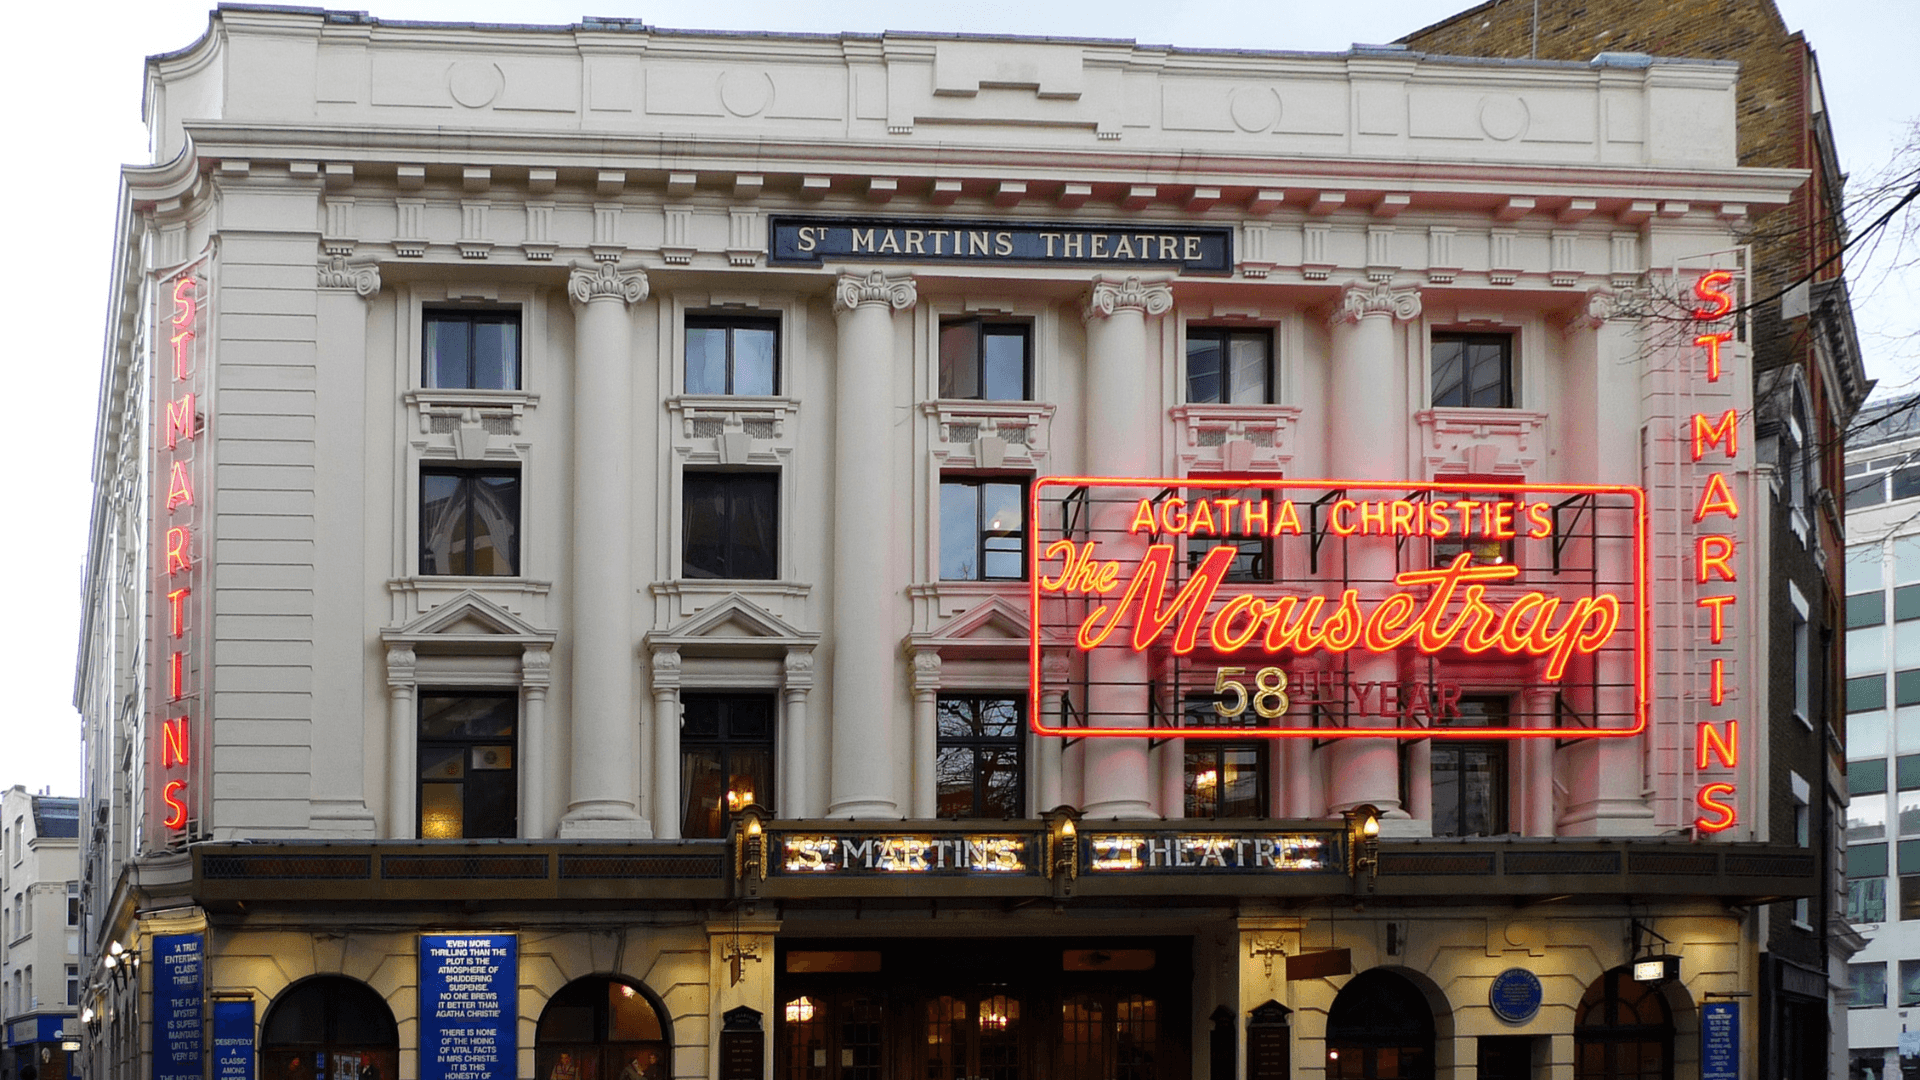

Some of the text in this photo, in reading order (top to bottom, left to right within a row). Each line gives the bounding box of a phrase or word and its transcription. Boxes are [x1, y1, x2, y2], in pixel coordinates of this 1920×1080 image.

[797, 227, 1203, 261] ST MARTINS THEATRE
[1129, 497, 1554, 539] AGATHA CHRISTIE'S
[1042, 540, 1121, 593] The
[162, 392, 196, 831] MARTINS
[1077, 545, 1621, 681] Mousetrap
[1691, 408, 1739, 833] MARTINS
[1351, 680, 1463, 719] YEAR
[841, 839, 1018, 869] MARTINS
[1127, 838, 1299, 867] THEATRE
[469, 940, 491, 948] MORE
[430, 948, 507, 957] THRILLING THAN THE
[446, 957, 490, 965] PLOT IS THE
[438, 966, 499, 974] ATMOSPHERE OF
[445, 975, 492, 983] SHUDDERING
[440, 992, 497, 1001] NO ONE BREWS
[438, 1001, 498, 1009] IT BETTER THAN
[436, 1010, 465, 1018] AGATHA
[467, 1028, 474, 1036] IS
[476, 1028, 497, 1036] NONE
[441, 1037, 494, 1045] OF THE HIDING
[440, 1046, 497, 1054] OF VITAL FACTS
[220, 1057, 247, 1065] CLASSIC
[437, 1055, 445, 1063] IN
[446, 1055, 462, 1063] MRS
[451, 1063, 486, 1071] IT IS THIS
[445, 1072, 492, 1080] HONESTY OF
